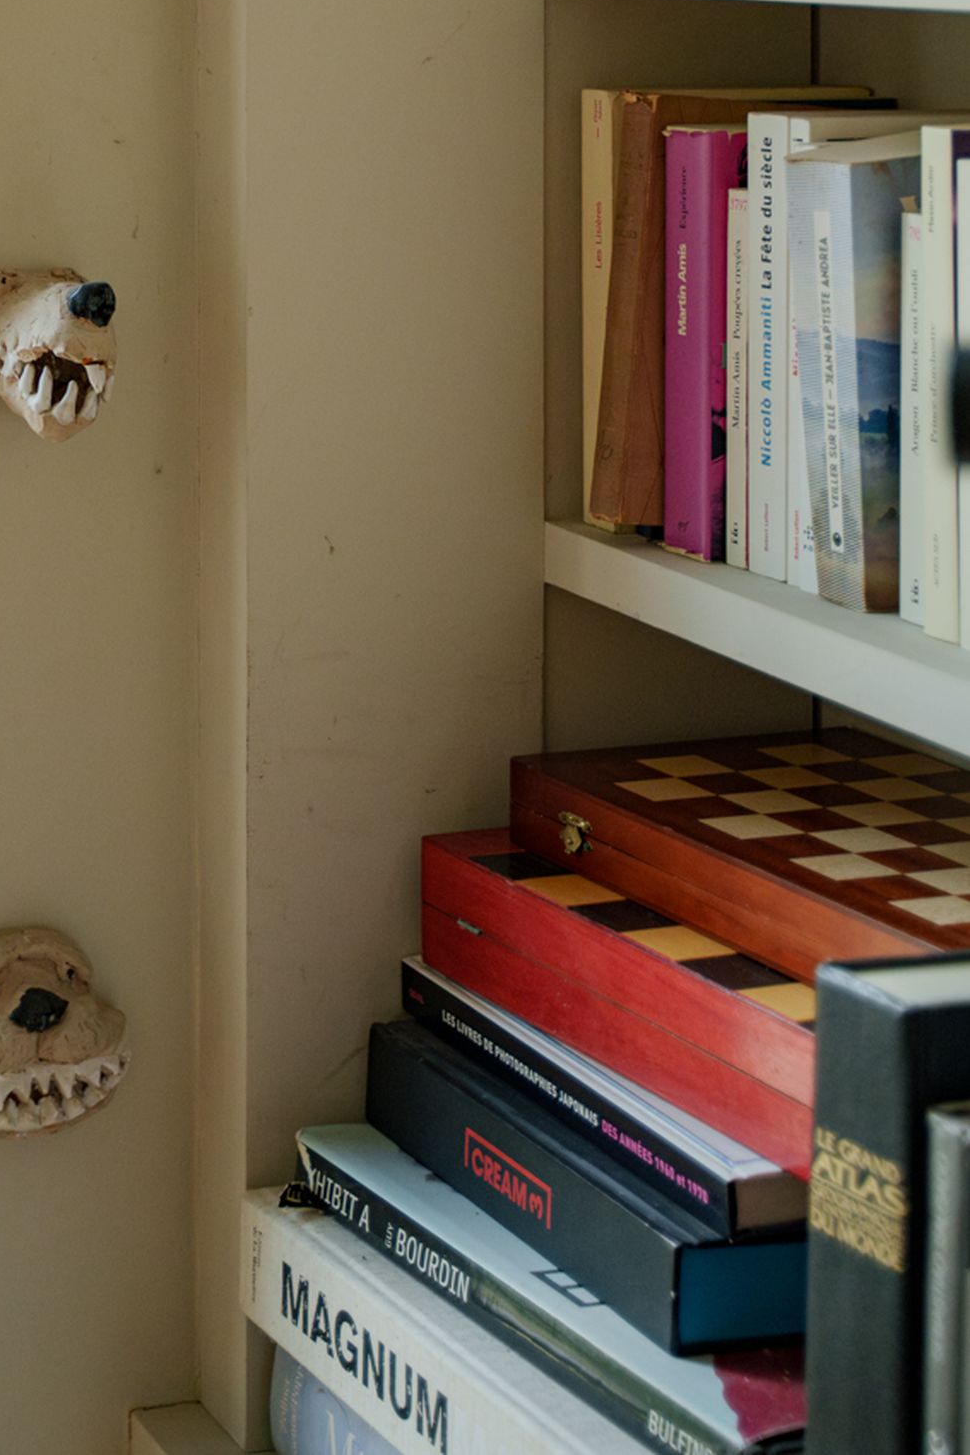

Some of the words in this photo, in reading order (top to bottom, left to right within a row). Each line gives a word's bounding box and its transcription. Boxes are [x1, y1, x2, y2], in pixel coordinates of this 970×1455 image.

[759, 136, 773, 190] siècle
[593, 200, 604, 245] Lisières
[676, 165, 689, 230] Expérience
[759, 194, 773, 218] du
[594, 248, 604, 270] Les
[676, 242, 688, 283] Amis
[731, 239, 743, 285] crevées
[759, 224, 773, 264] Fête
[818, 236, 831, 288] ANDREA
[760, 269, 773, 290] La
[676, 284, 688, 337] Martin
[731, 287, 743, 340] Poupées
[731, 351, 742, 384] Amis
[760, 296, 772, 391] Ammaniti
[909, 338, 919, 394] Blanche
[731, 387, 742, 429] Martin
[760, 397, 772, 467] Niccolò
[826, 404, 838, 430] ELLE
[909, 406, 921, 457] Aragon
[827, 434, 839, 459] SUR
[830, 461, 841, 510] VEILLER
[441, 1009, 456, 1029] LES
[456, 1018, 484, 1047] LIVRES
[483, 1034, 495, 1054] DE
[494, 1041, 559, 1100] PHOTOGRAPHIES
[558, 1086, 599, 1128] JAPONAIS
[601, 1118, 620, 1140] DES
[618, 1127, 654, 1167] ANNÉES
[654, 1155, 677, 1183] 1960
[675, 1169, 686, 1187] et
[815, 1124, 839, 1156] LE
[470, 1148, 529, 1213] CREAM
[810, 1151, 908, 1219] ATLAS
[357, 1204, 371, 1233] A
[385, 1223, 394, 1250] GUY
[395, 1228, 470, 1304] BOURDIN
[281, 1261, 449, 1453] MAGNUM
